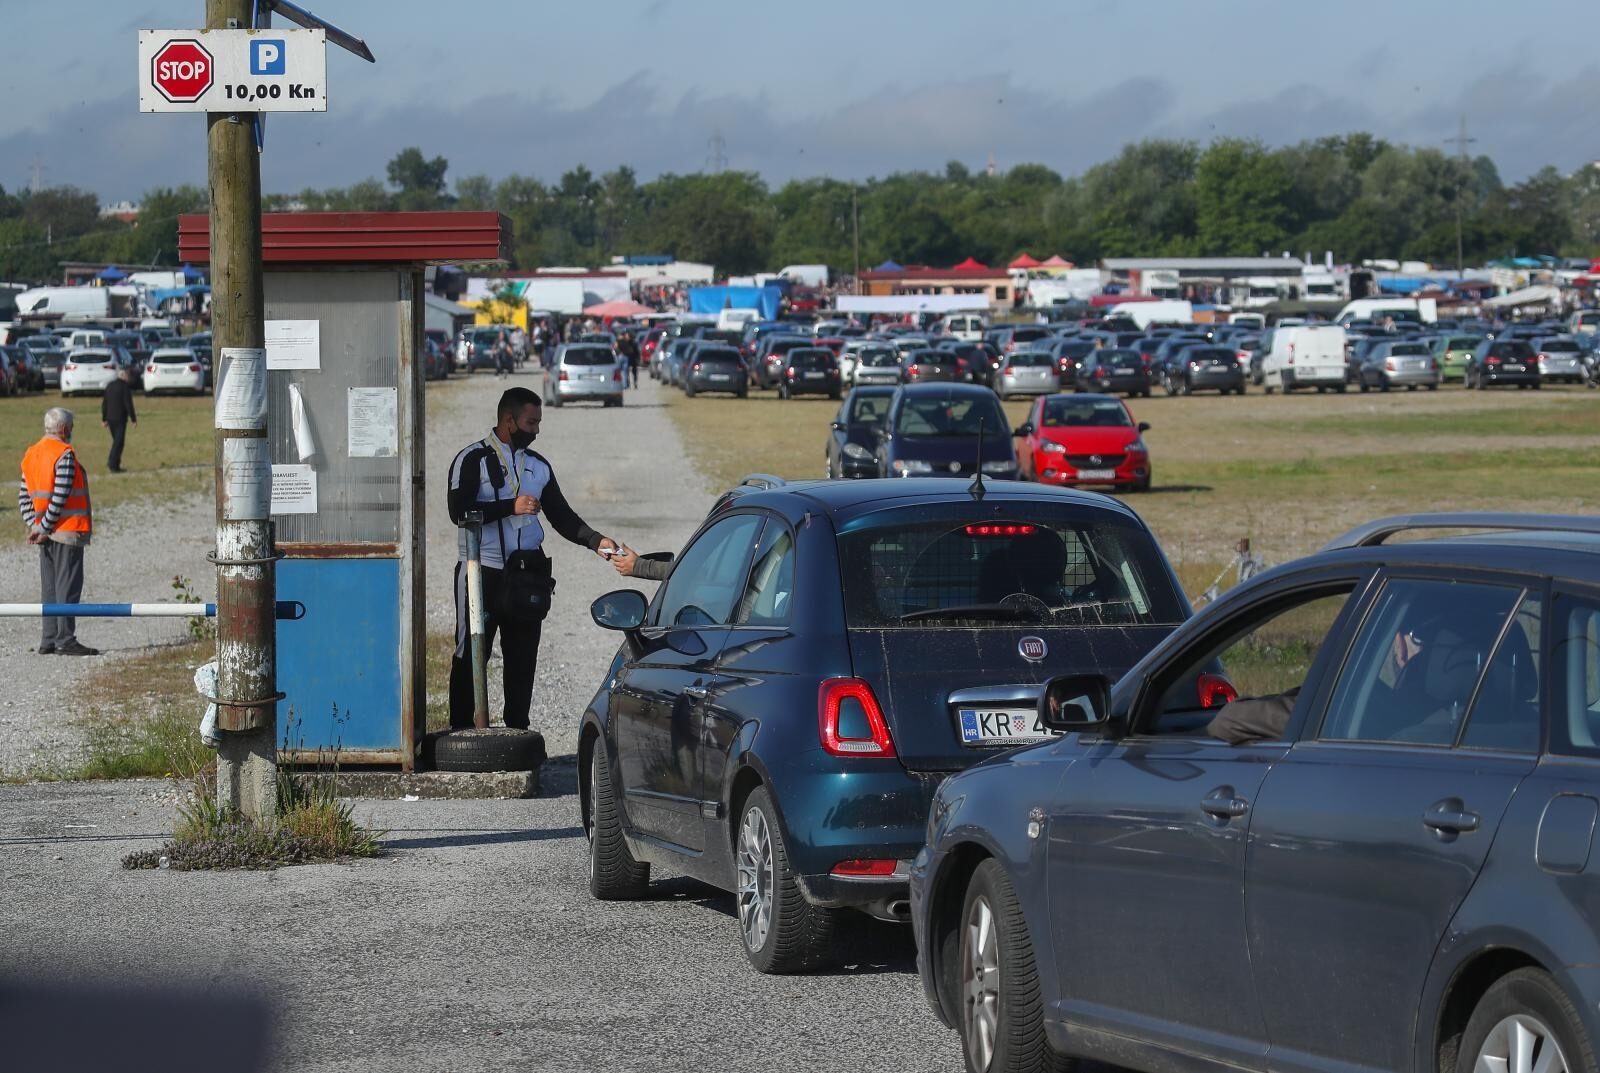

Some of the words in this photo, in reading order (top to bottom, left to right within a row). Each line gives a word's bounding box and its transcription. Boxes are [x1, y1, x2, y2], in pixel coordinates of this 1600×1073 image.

[258, 44, 279, 71] P
[159, 61, 206, 81] STOP
[224, 84, 281, 102] 10,00
[289, 84, 316, 99] Kn
[1024, 642, 1042, 654] FIAT
[965, 728, 977, 737] HR
[979, 712, 1012, 737] KR
